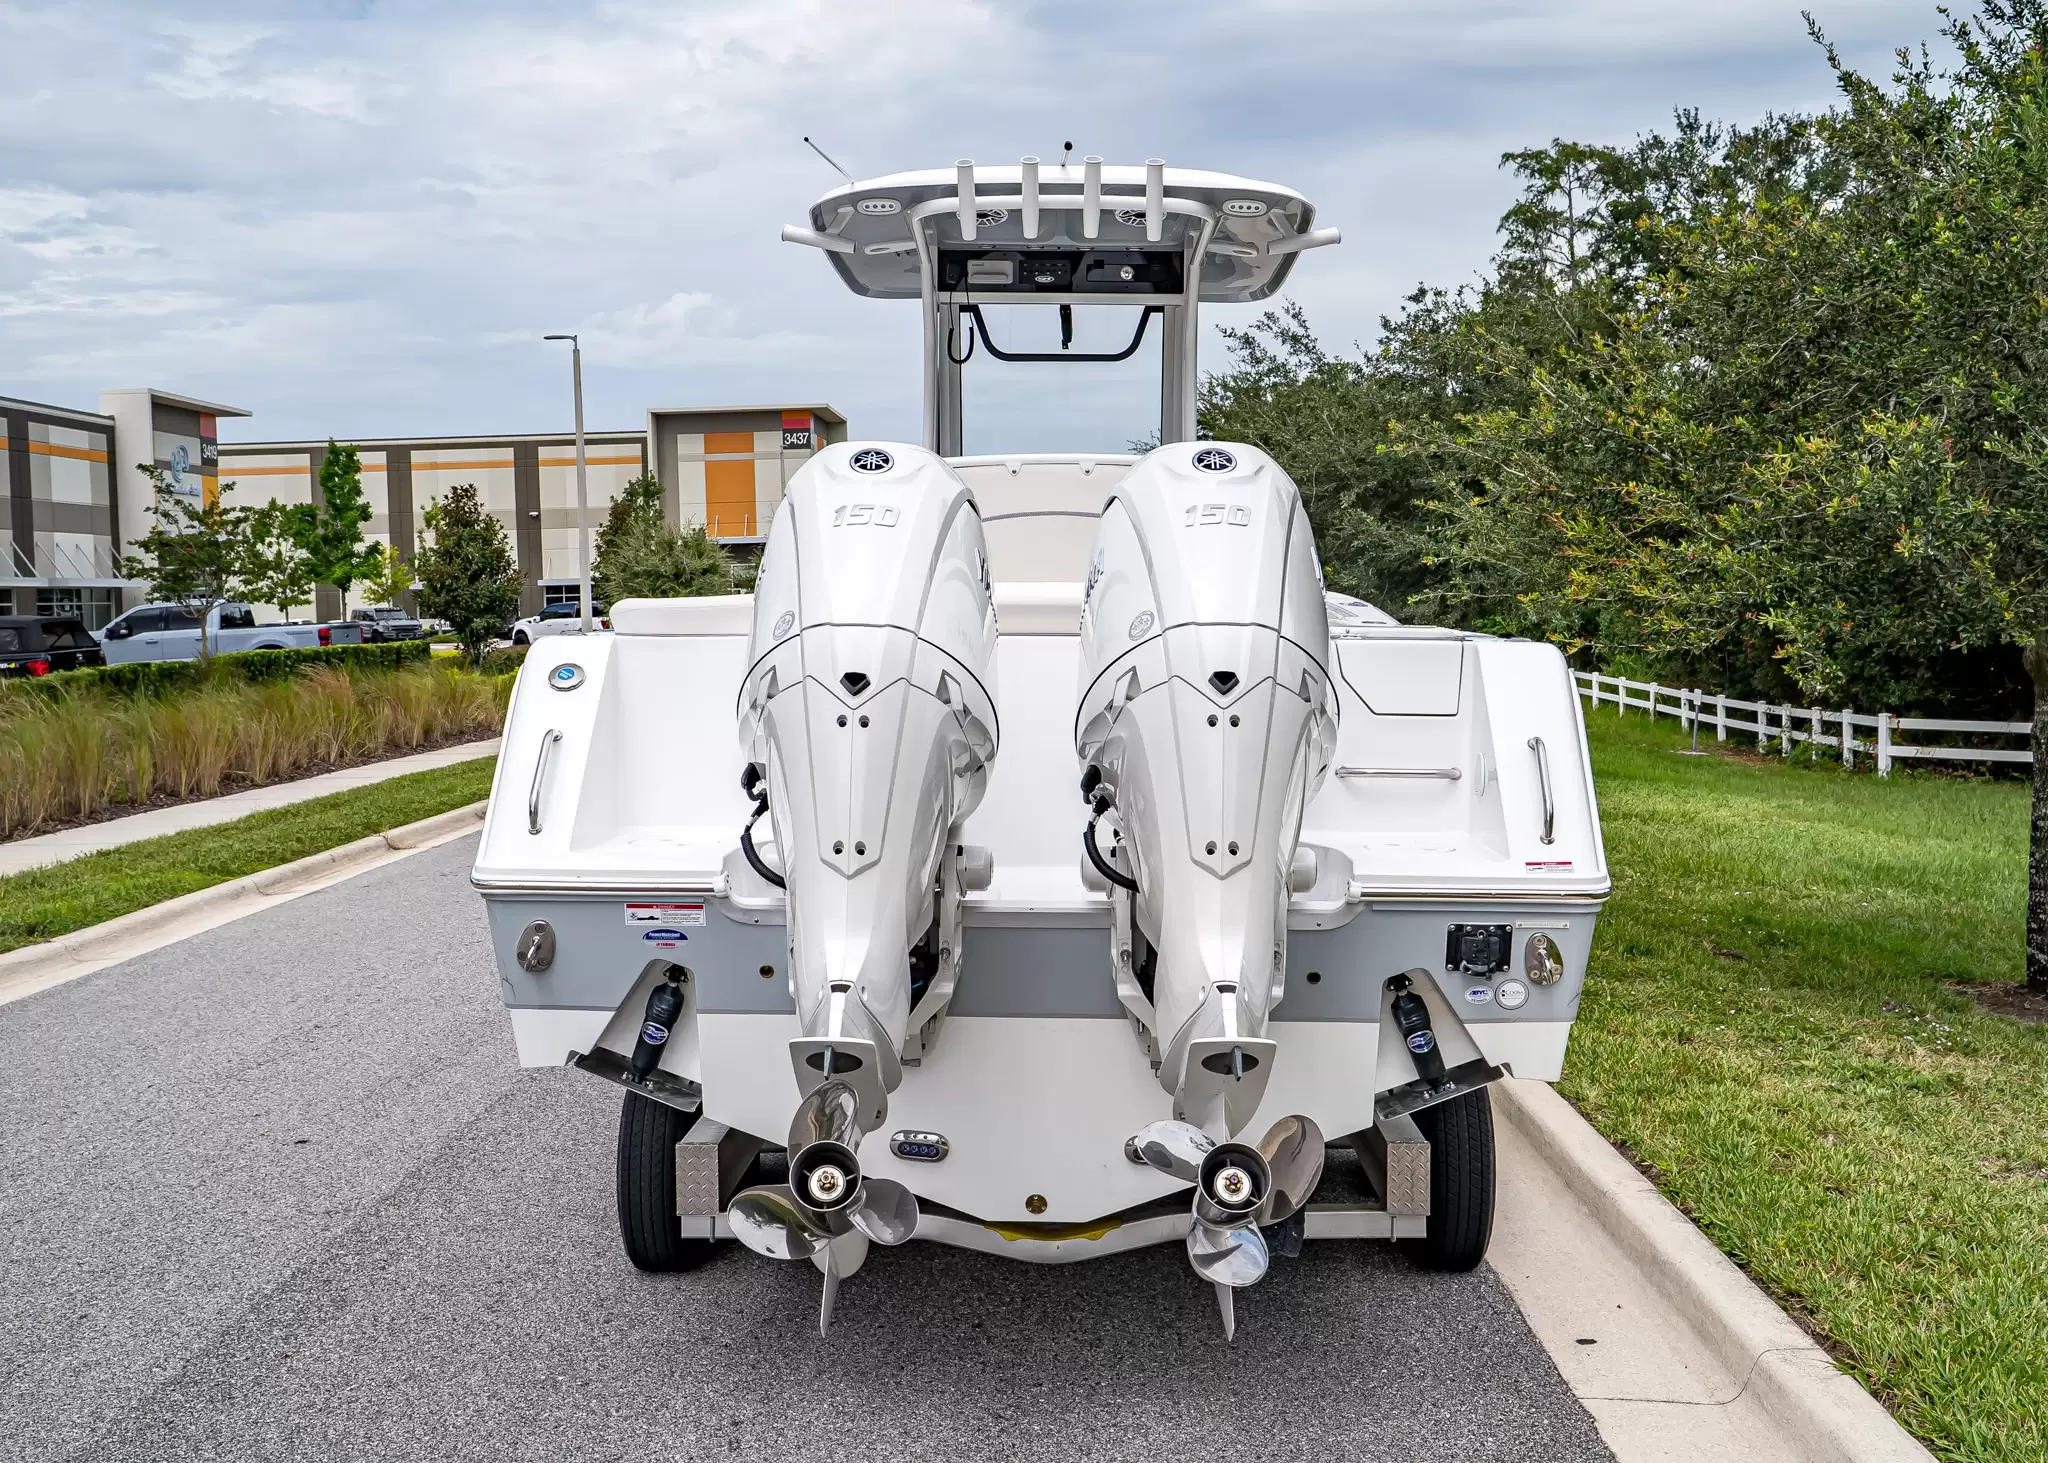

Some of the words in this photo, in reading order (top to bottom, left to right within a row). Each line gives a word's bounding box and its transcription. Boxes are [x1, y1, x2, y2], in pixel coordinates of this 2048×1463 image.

[784, 433, 809, 444] 3437
[202, 444, 217, 459] 3419
[833, 503, 901, 527] 150
[1185, 503, 1251, 527] 150
